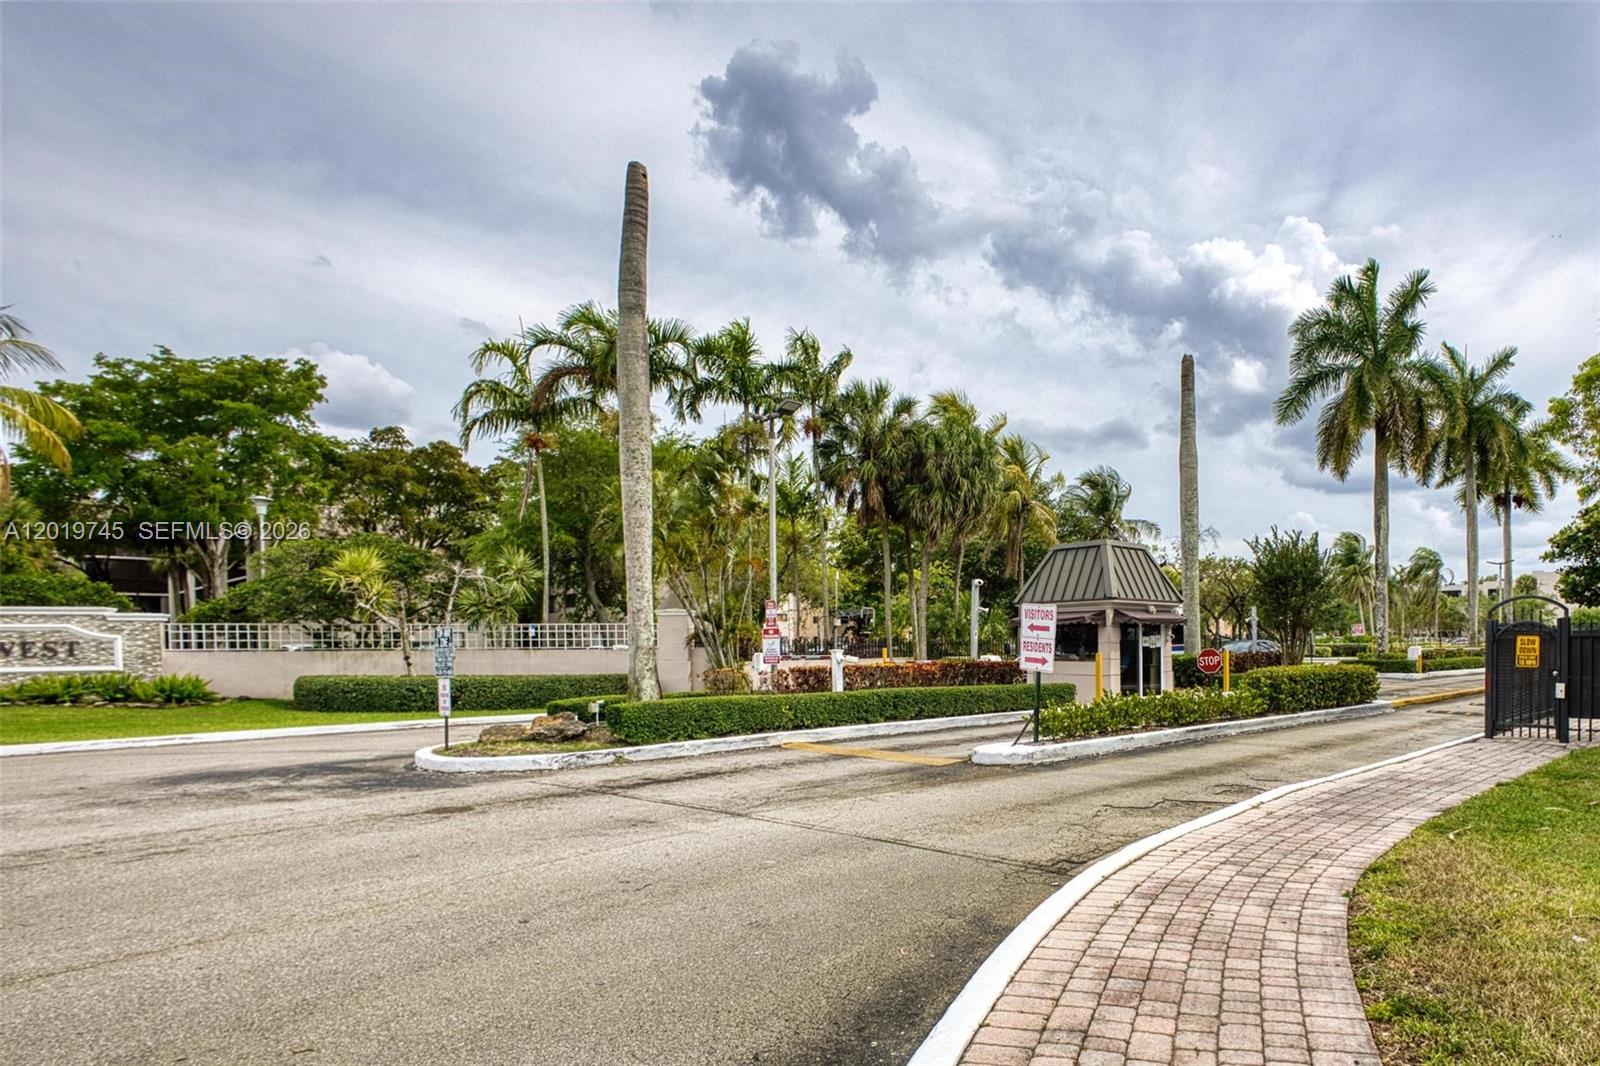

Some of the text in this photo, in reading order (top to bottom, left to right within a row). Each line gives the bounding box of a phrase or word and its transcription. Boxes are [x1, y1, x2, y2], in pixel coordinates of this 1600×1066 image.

[1024, 609, 1053, 621] VISITORS
[1023, 641, 1051, 654] RESIDENTS
[1520, 638, 1536, 646] SLOW
[1199, 655, 1220, 667] STOP
